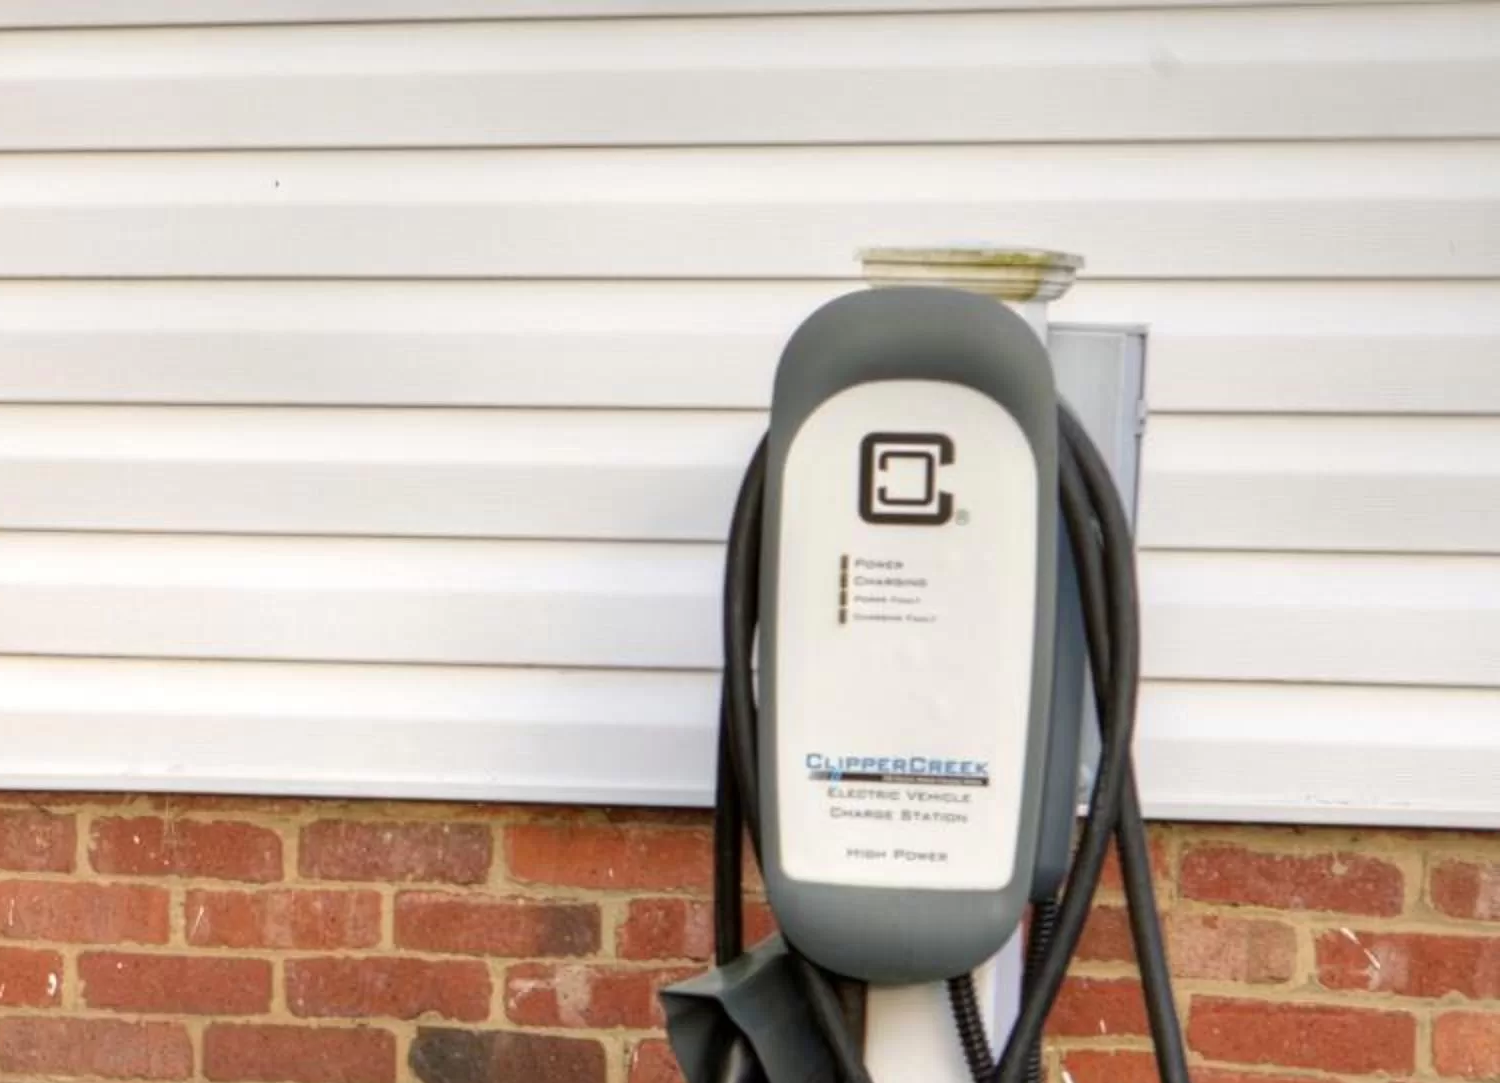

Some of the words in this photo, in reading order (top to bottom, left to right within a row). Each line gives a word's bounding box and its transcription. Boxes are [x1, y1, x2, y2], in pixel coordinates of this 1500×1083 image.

[827, 786, 900, 800] ELECTRIC
[905, 789, 972, 803] VEHICLE
[829, 806, 893, 821] CHARGE
[901, 808, 968, 824] STATION
[893, 848, 948, 863] POWER
